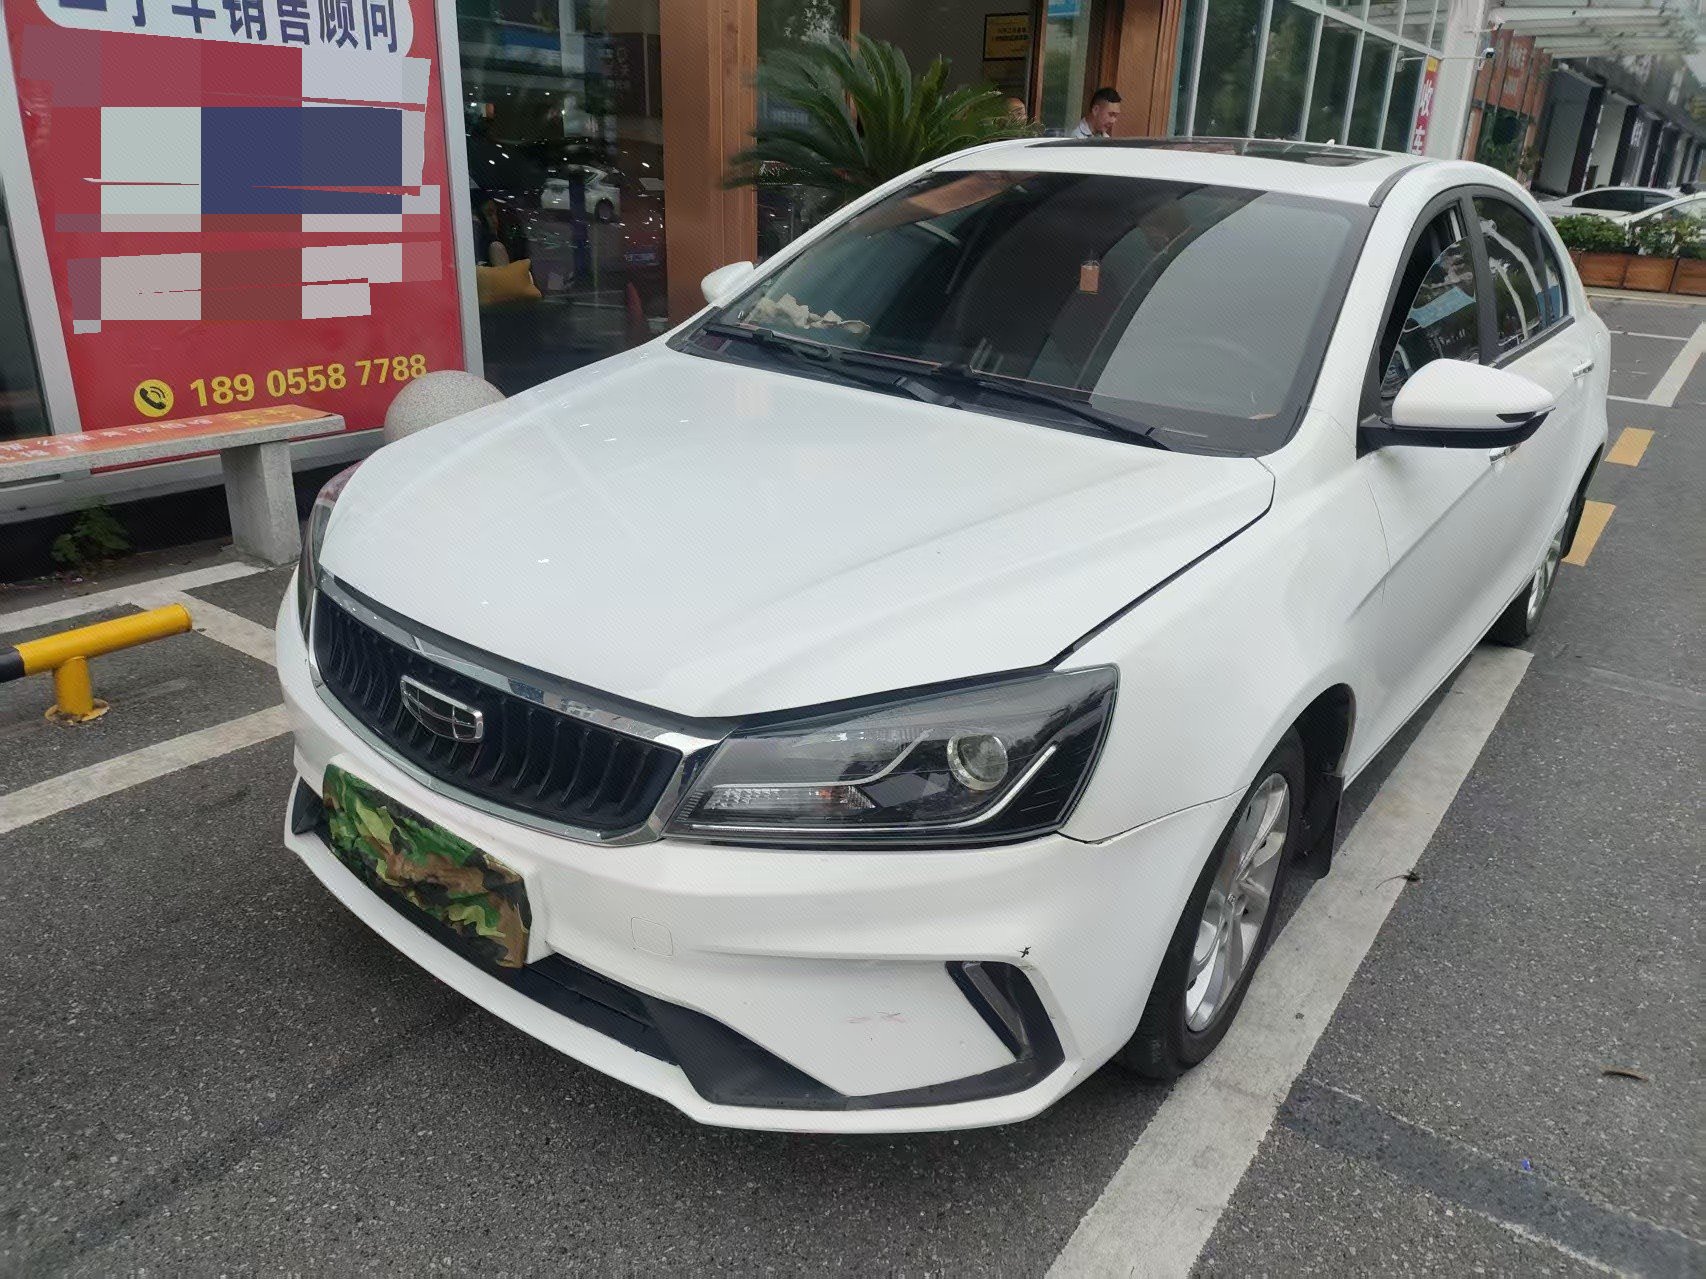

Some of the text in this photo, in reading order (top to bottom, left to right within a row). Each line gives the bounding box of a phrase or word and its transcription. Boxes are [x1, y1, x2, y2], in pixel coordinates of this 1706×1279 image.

[190, 354, 427, 407] 189 0558 7788
